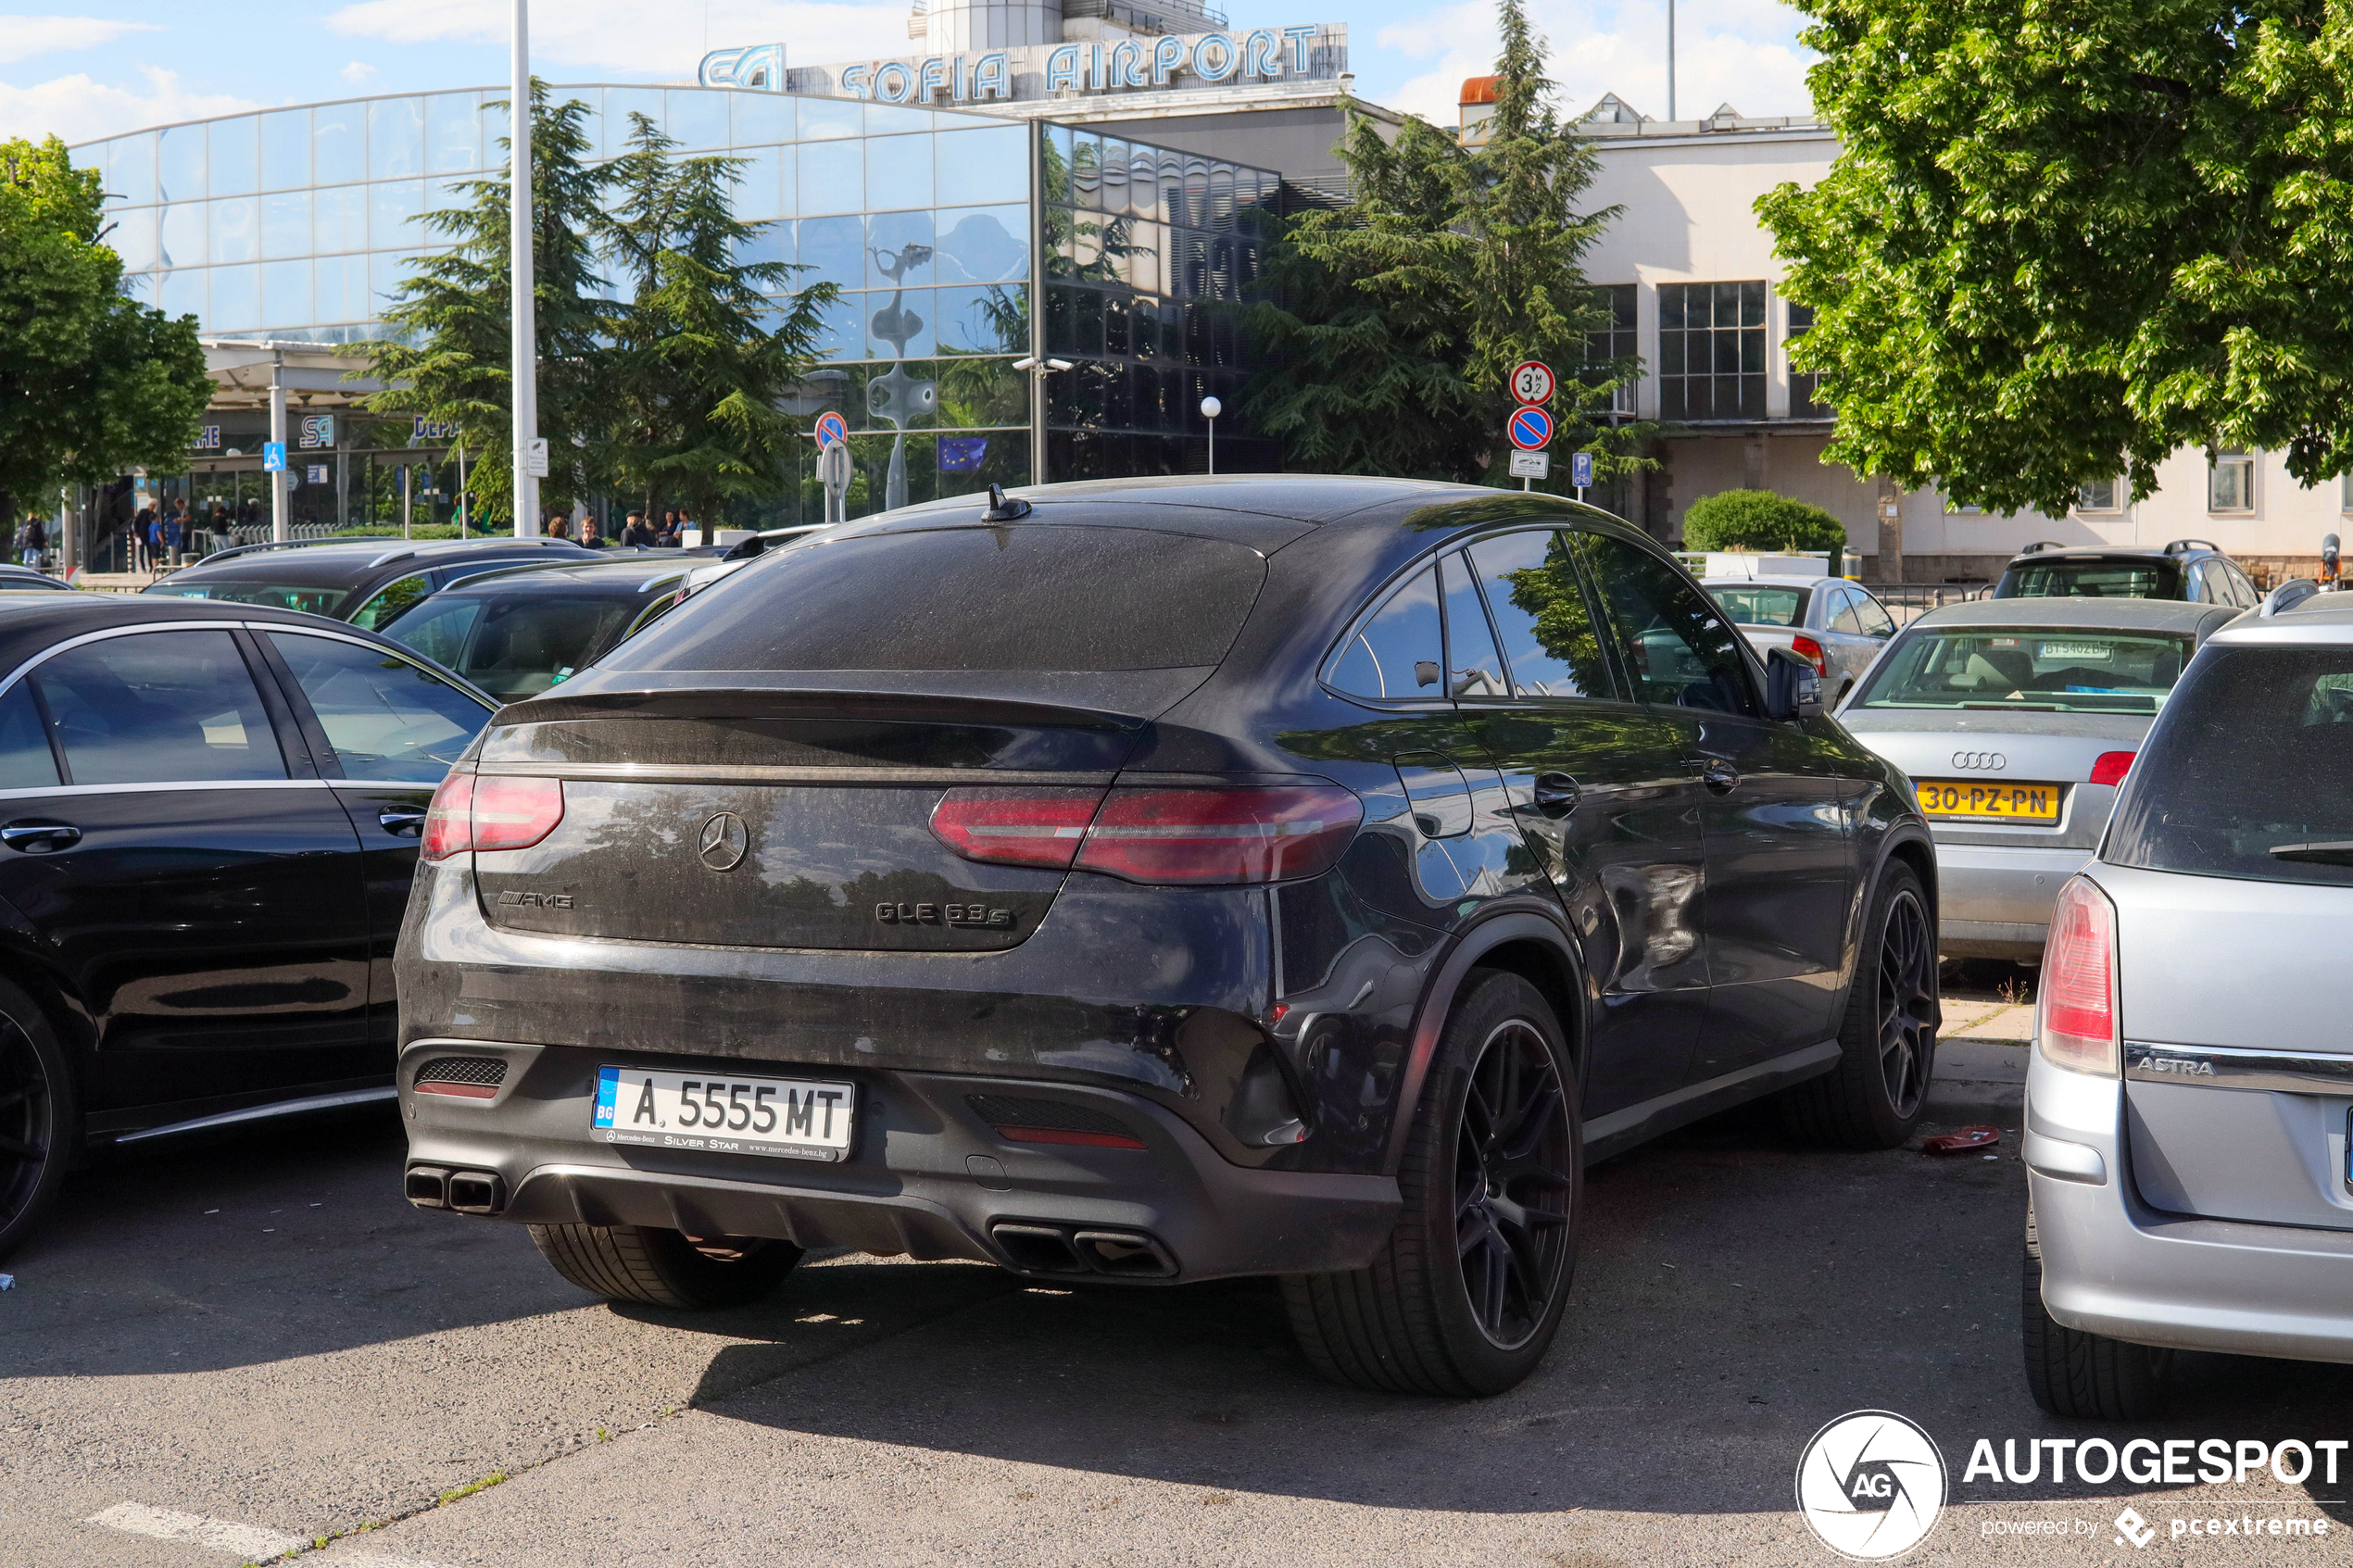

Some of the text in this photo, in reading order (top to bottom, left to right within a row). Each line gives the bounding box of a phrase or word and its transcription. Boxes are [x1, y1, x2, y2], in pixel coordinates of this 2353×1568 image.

[841, 23, 1319, 105] SOFIA AIRPORT
[1578, 456, 1588, 472] P
[2045, 643, 2060, 654] BT
[2062, 644, 2091, 654] 5402
[1925, 786, 2046, 813] 30-PZ-PN
[520, 892, 574, 910] AMG
[875, 902, 936, 921] GLE
[2137, 1056, 2218, 1076] ASTRA
[633, 1077, 656, 1125] A
[596, 1105, 613, 1120] BG
[616, 1133, 739, 1150] Mercedes-Benz SILVER STAR
[749, 1145, 827, 1159] www.mercedes-benz.bg
